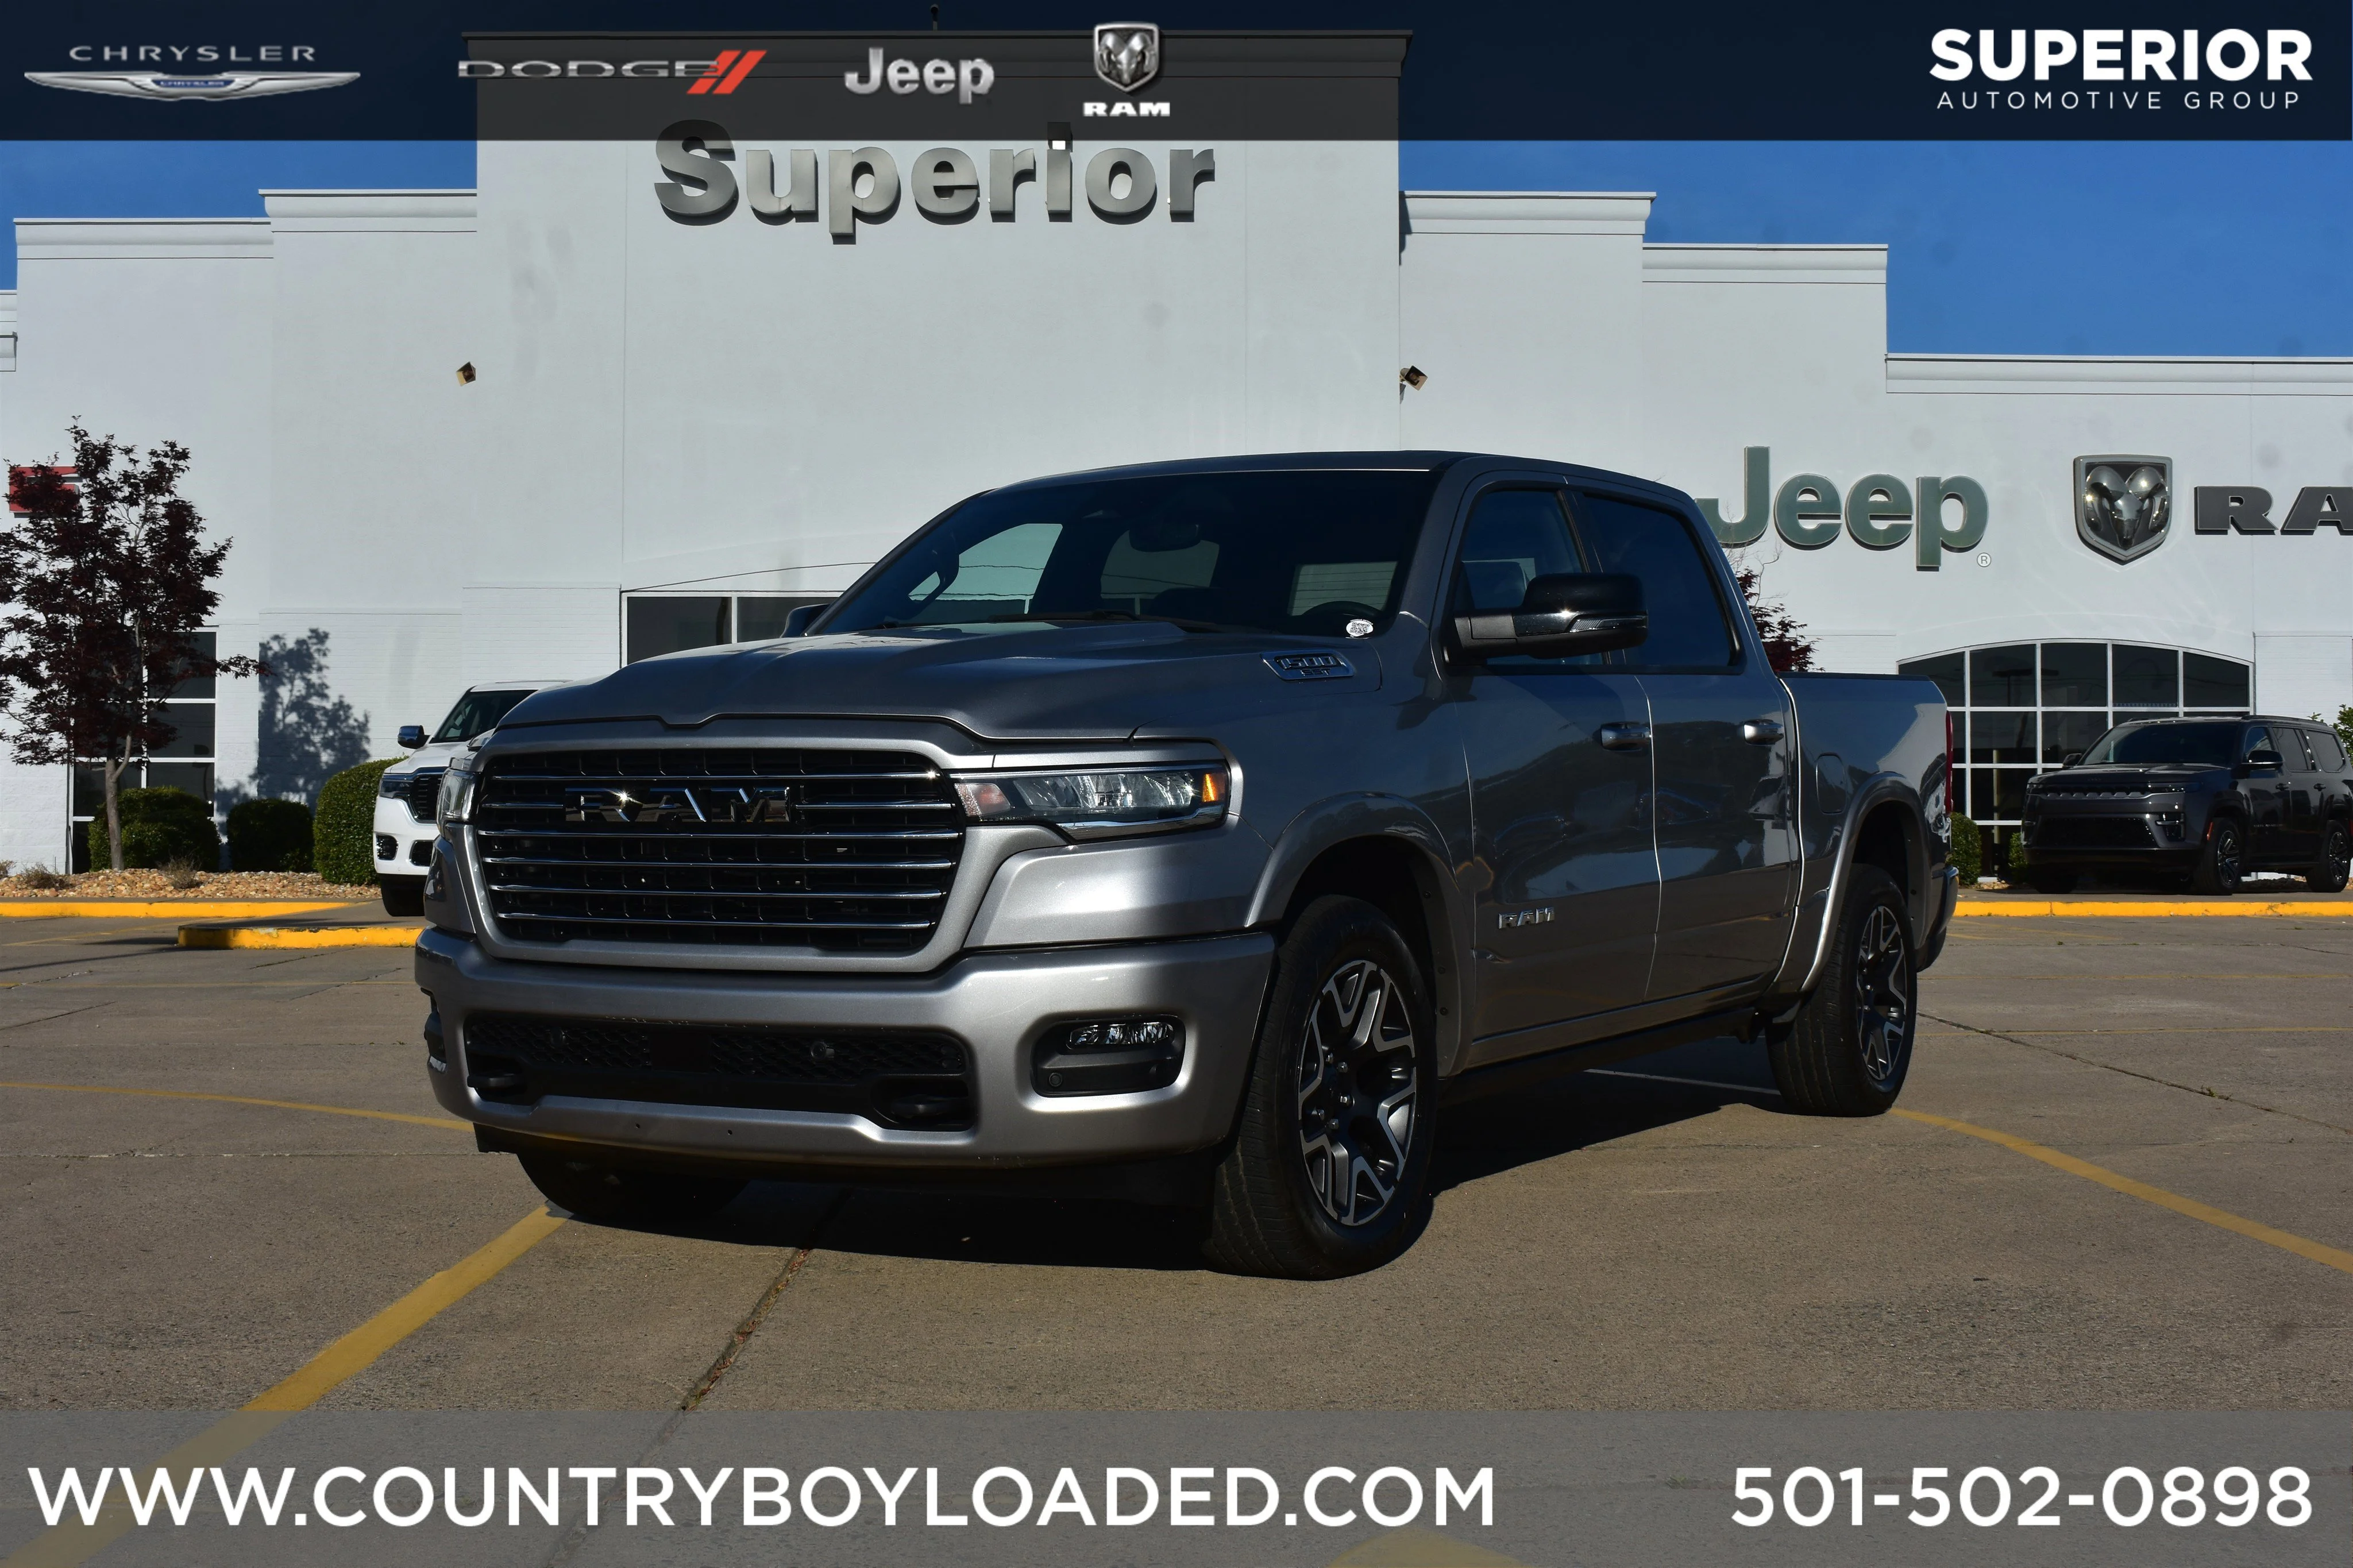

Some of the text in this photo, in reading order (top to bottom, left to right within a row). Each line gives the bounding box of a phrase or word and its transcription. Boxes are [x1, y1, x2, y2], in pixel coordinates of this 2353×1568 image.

[654, 119, 1214, 242] Superior
[1695, 446, 1989, 570] Jeep
[1276, 656, 1337, 669] 1500
[565, 787, 790, 822] RAM
[1498, 907, 1555, 929] RAM
